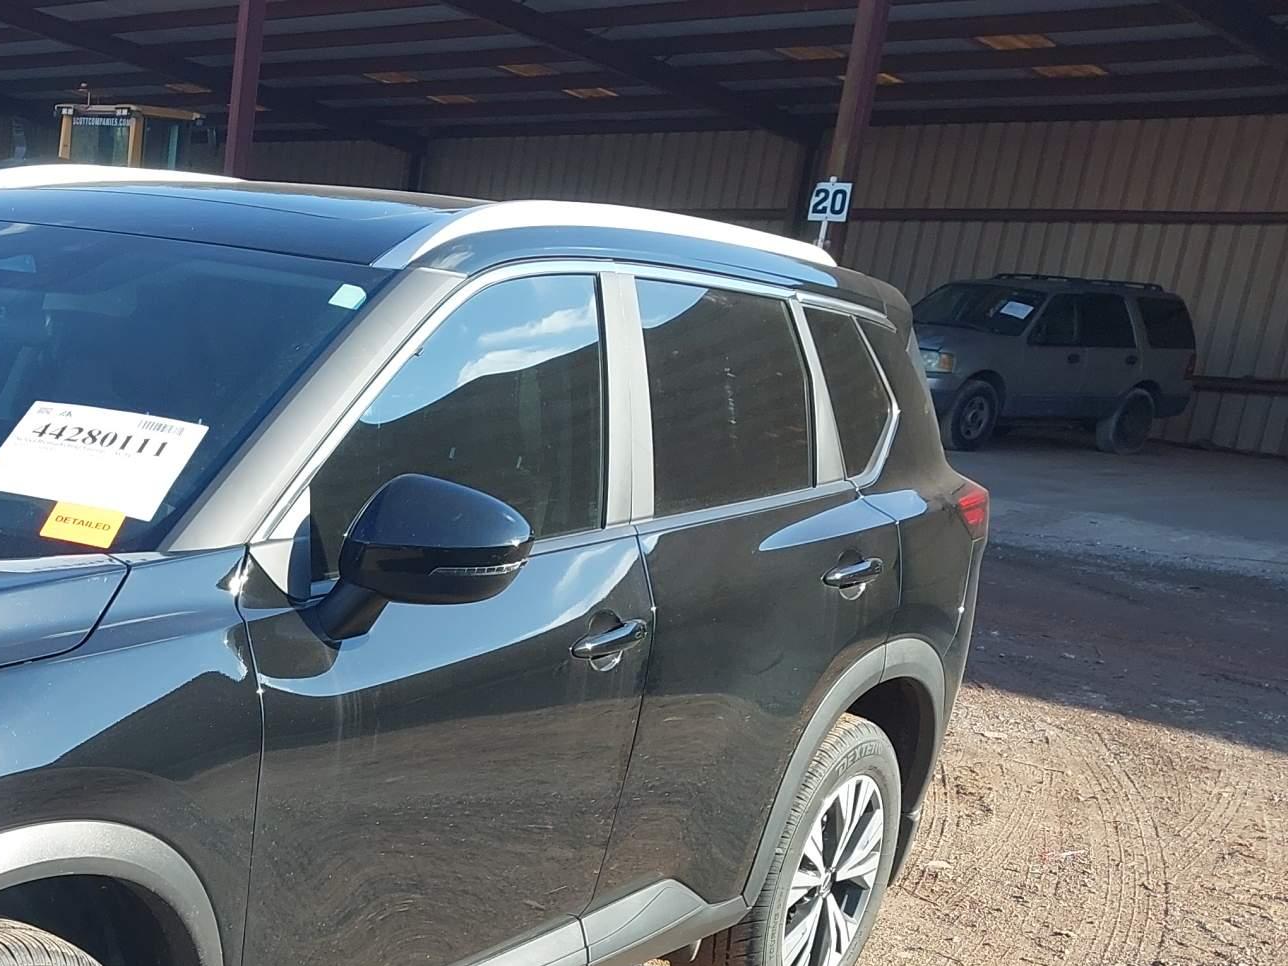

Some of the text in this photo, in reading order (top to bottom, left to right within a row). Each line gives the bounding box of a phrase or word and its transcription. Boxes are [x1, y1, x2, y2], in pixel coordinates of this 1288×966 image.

[812, 188, 847, 215] 20
[32, 422, 168, 457] 44280111
[55, 514, 111, 532] DETAILED
